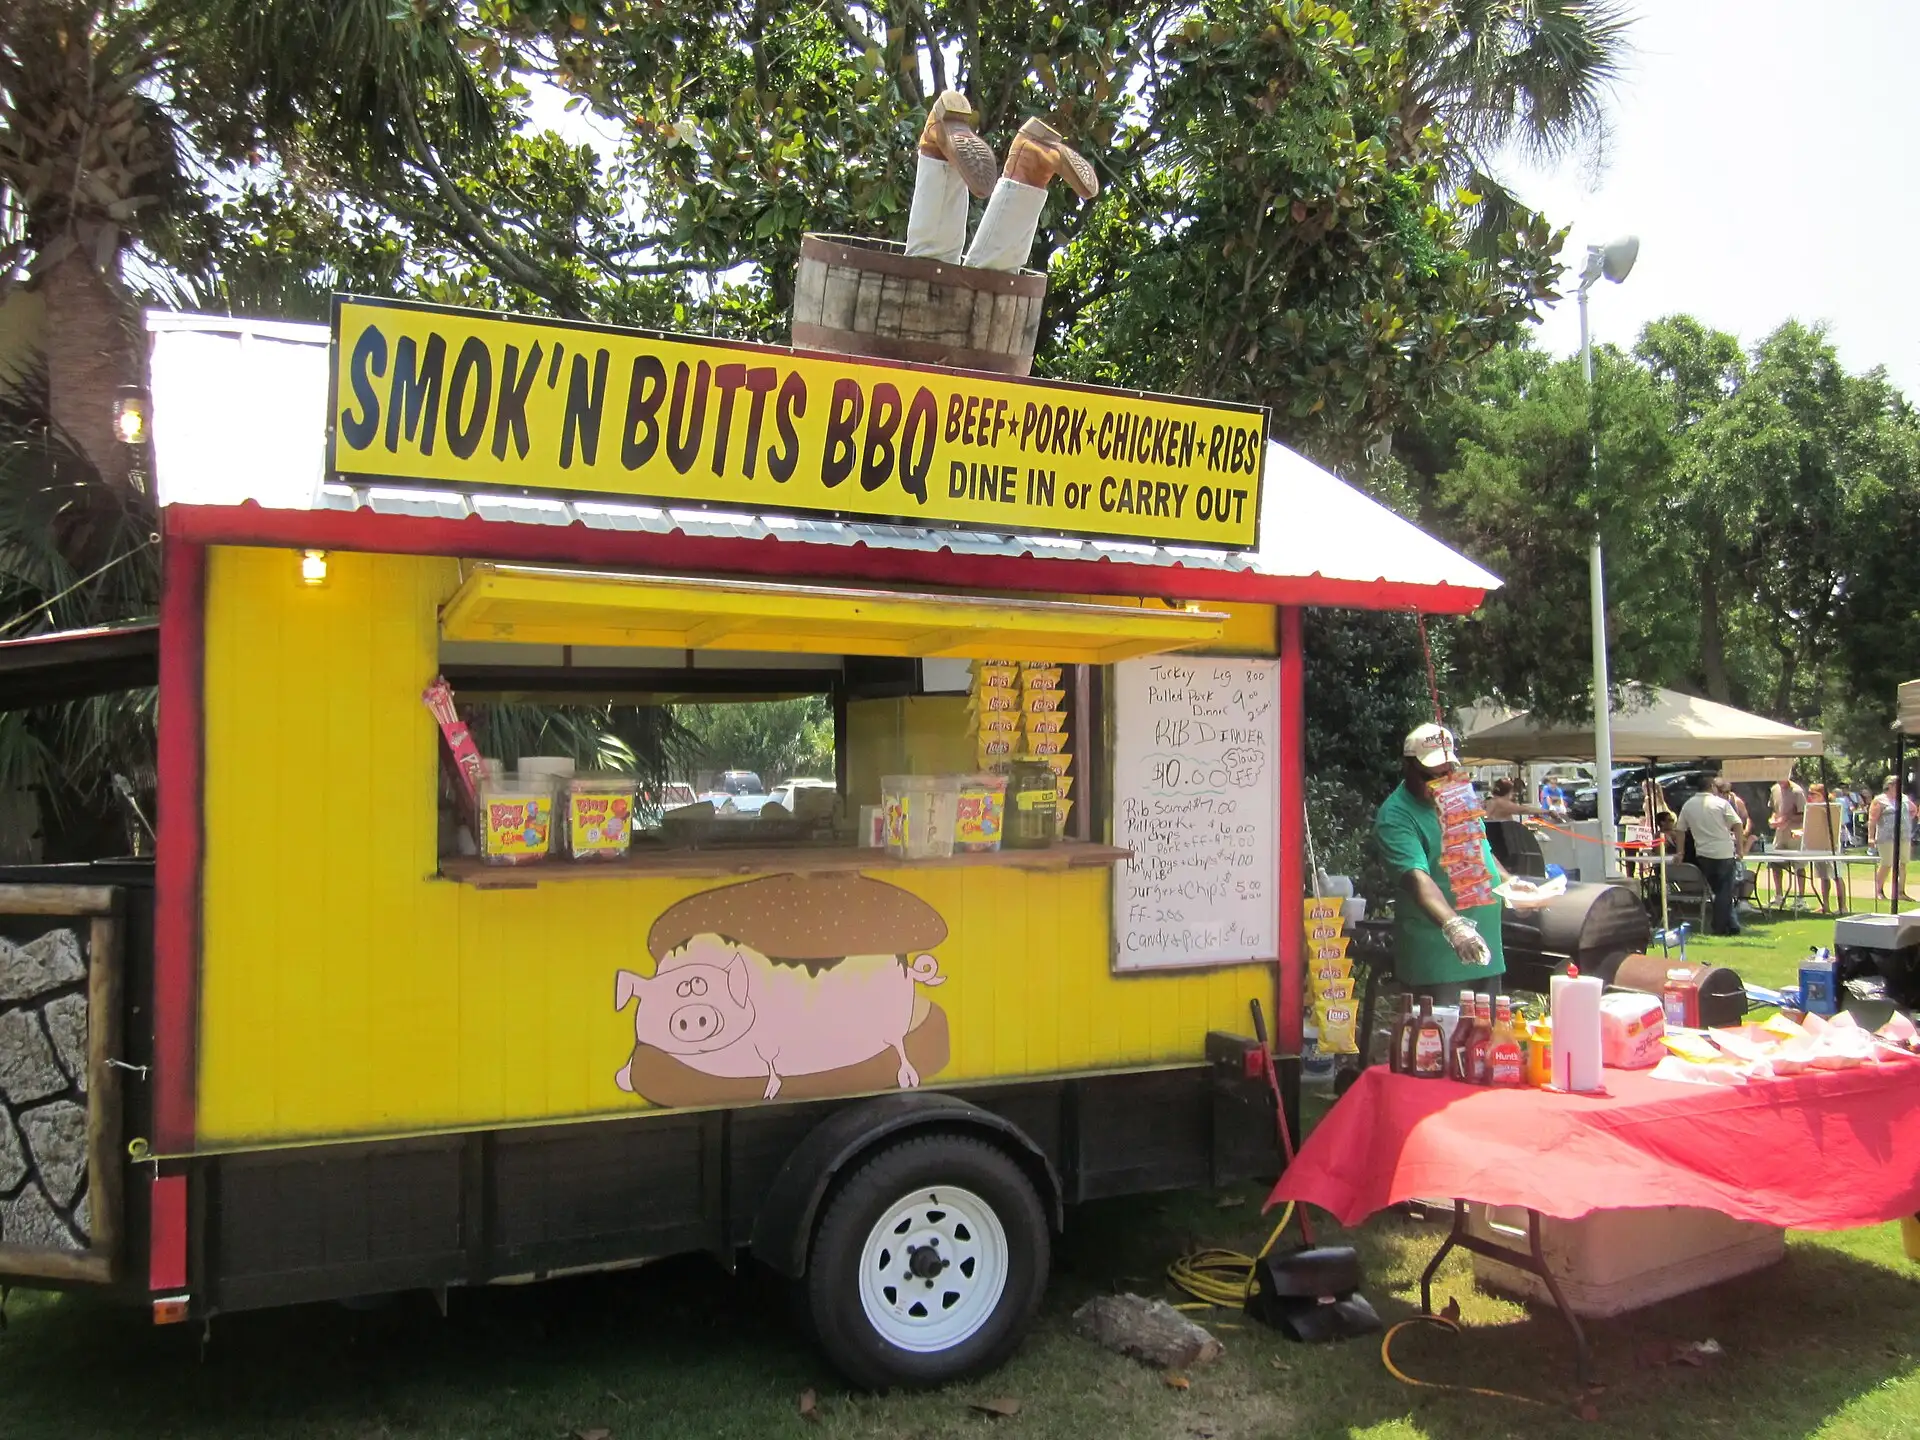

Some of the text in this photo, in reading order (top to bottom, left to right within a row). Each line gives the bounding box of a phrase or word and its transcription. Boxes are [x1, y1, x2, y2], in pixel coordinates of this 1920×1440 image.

[341, 324, 939, 504] SMOK'N BUTTS BBQ
[944, 393, 1259, 476] BEEF PORK CHICKEN RIBS
[949, 461, 1248, 524] DINE IN or CARRY OUT
[1213, 668, 1232, 687] Leg
[1149, 686, 1182, 704] Pulled
[1188, 690, 1214, 705] Pork
[1156, 719, 1190, 748] RIB
[1123, 798, 1149, 818] Rib
[1124, 817, 1147, 833] Pull
[1148, 831, 1181, 844] Chips
[1126, 857, 1144, 876] Hot
[1152, 856, 1178, 873] Dogs
[1126, 928, 1170, 952] Candy
